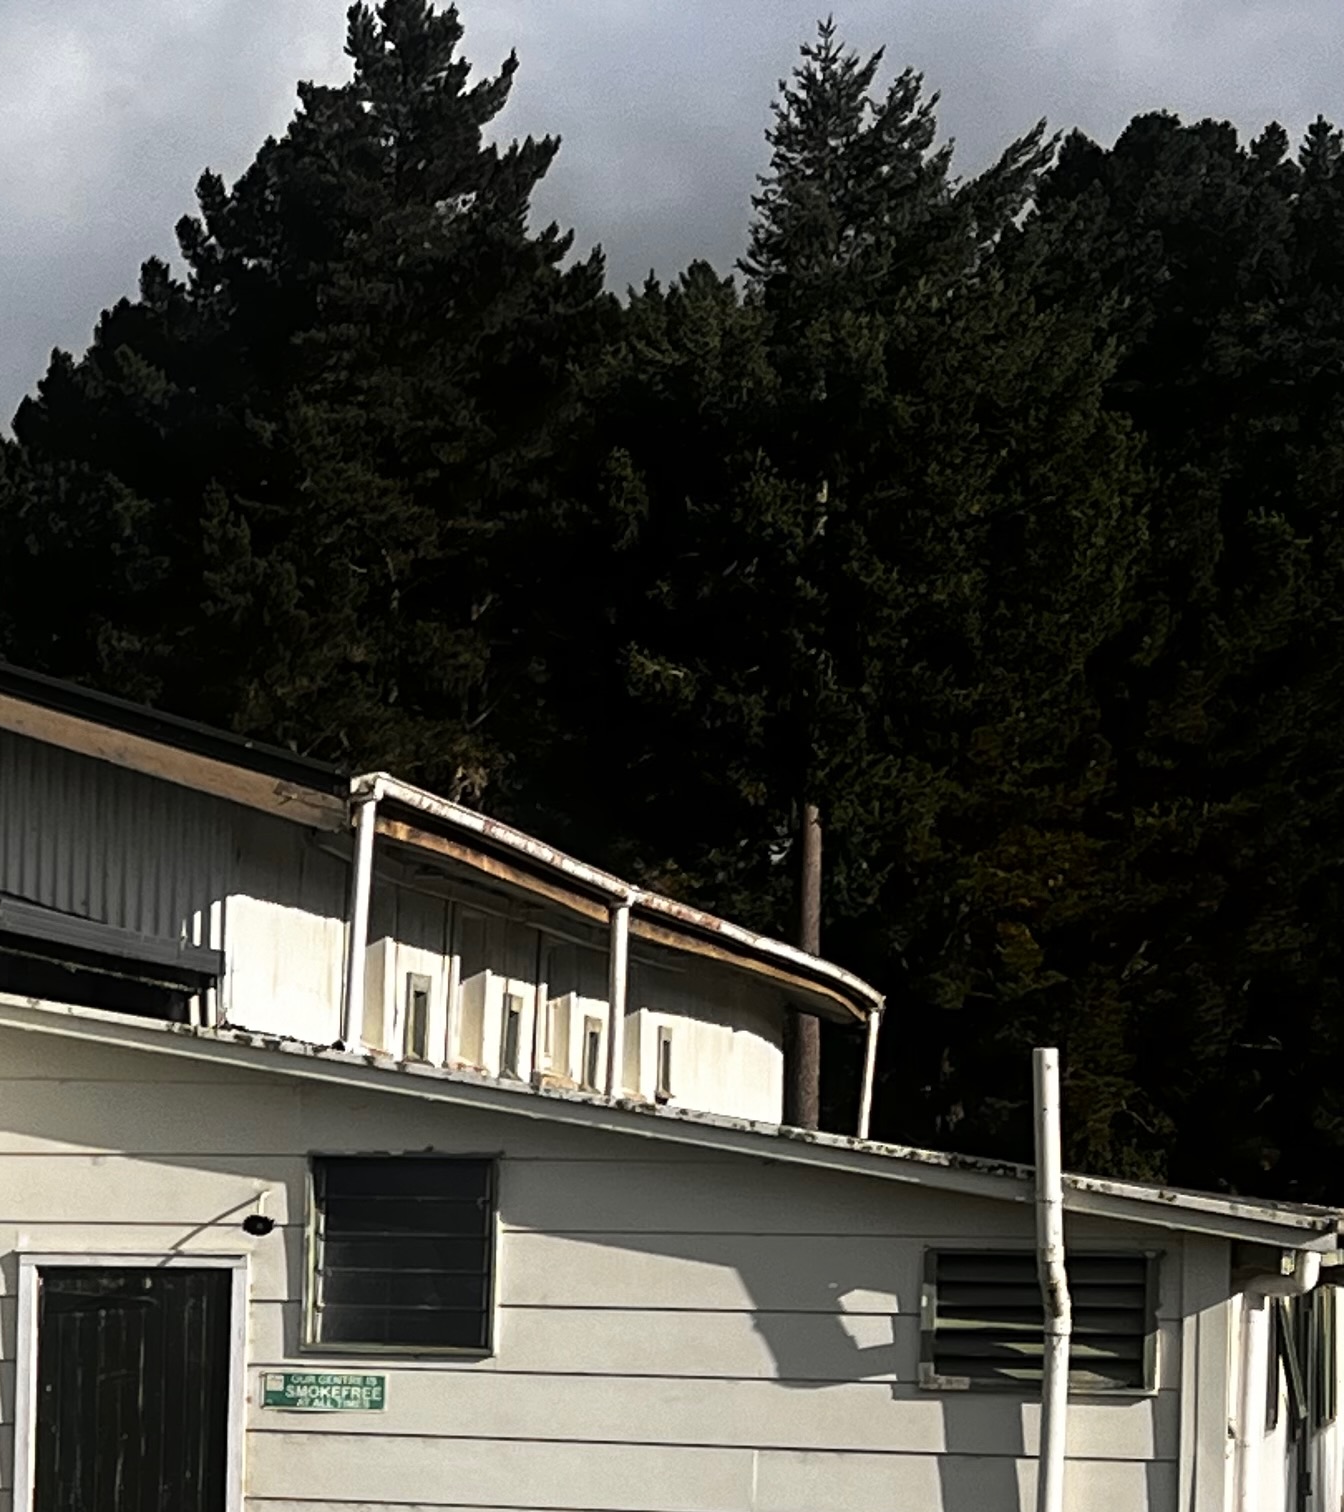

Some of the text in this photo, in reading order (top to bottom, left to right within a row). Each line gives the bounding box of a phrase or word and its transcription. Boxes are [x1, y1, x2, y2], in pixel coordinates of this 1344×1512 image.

[291, 1375, 315, 1384] OUR
[318, 1375, 363, 1386] CENTRE
[285, 1385, 382, 1401] SMOKEFREE
[313, 1399, 331, 1408] ALL
